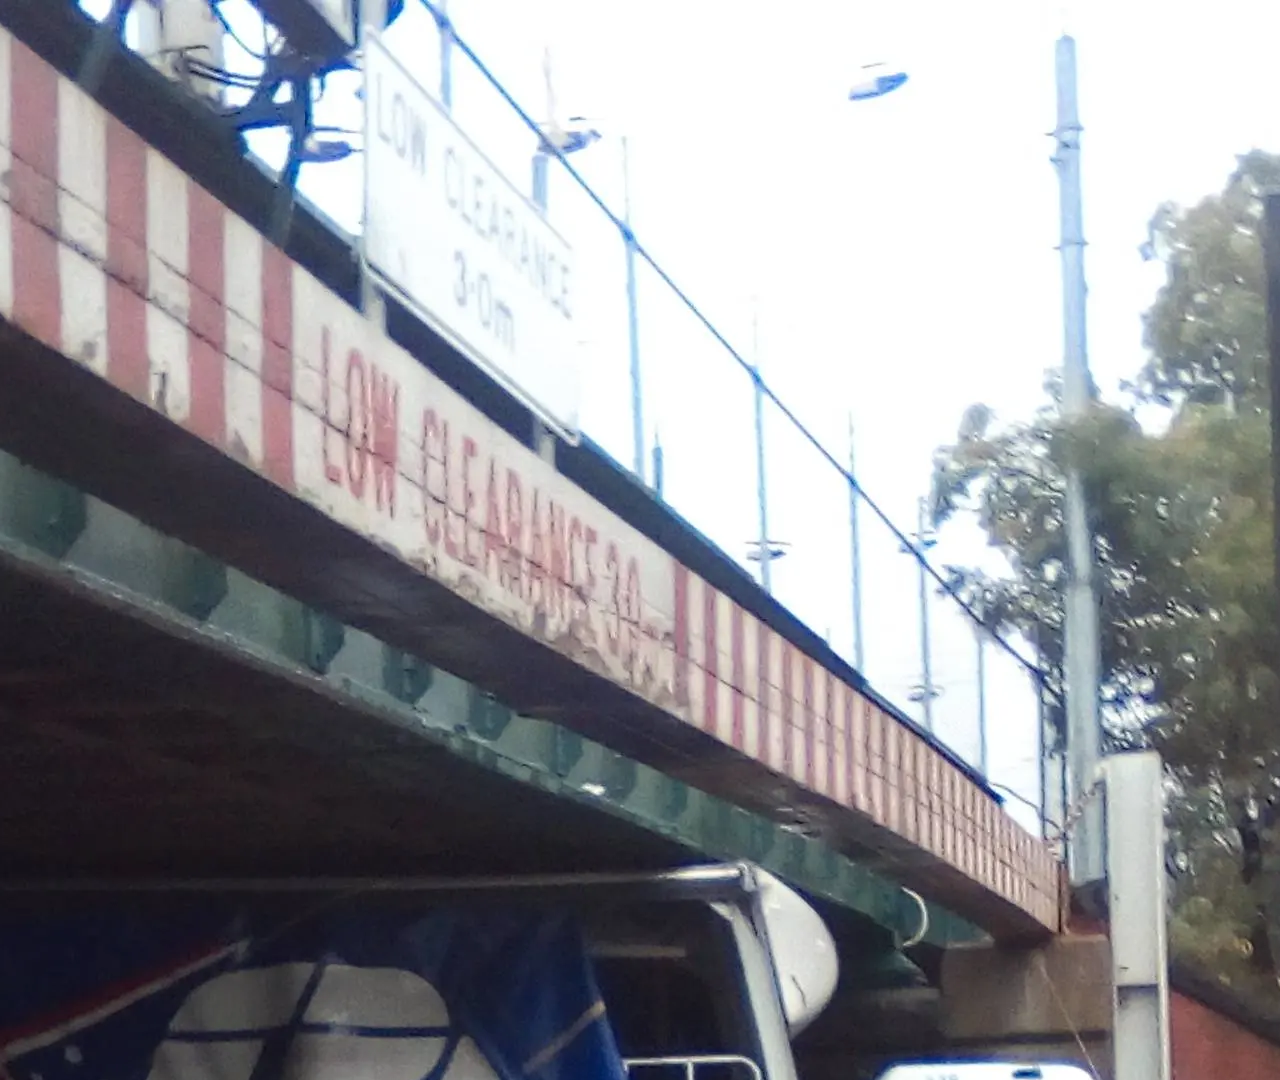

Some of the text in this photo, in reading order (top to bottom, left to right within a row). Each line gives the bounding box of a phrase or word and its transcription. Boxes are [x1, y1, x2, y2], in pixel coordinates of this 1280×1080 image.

[376, 72, 573, 321] LOW CLEARANCE
[322, 324, 400, 520] LOW
[423, 407, 598, 626] CLEARANCE
